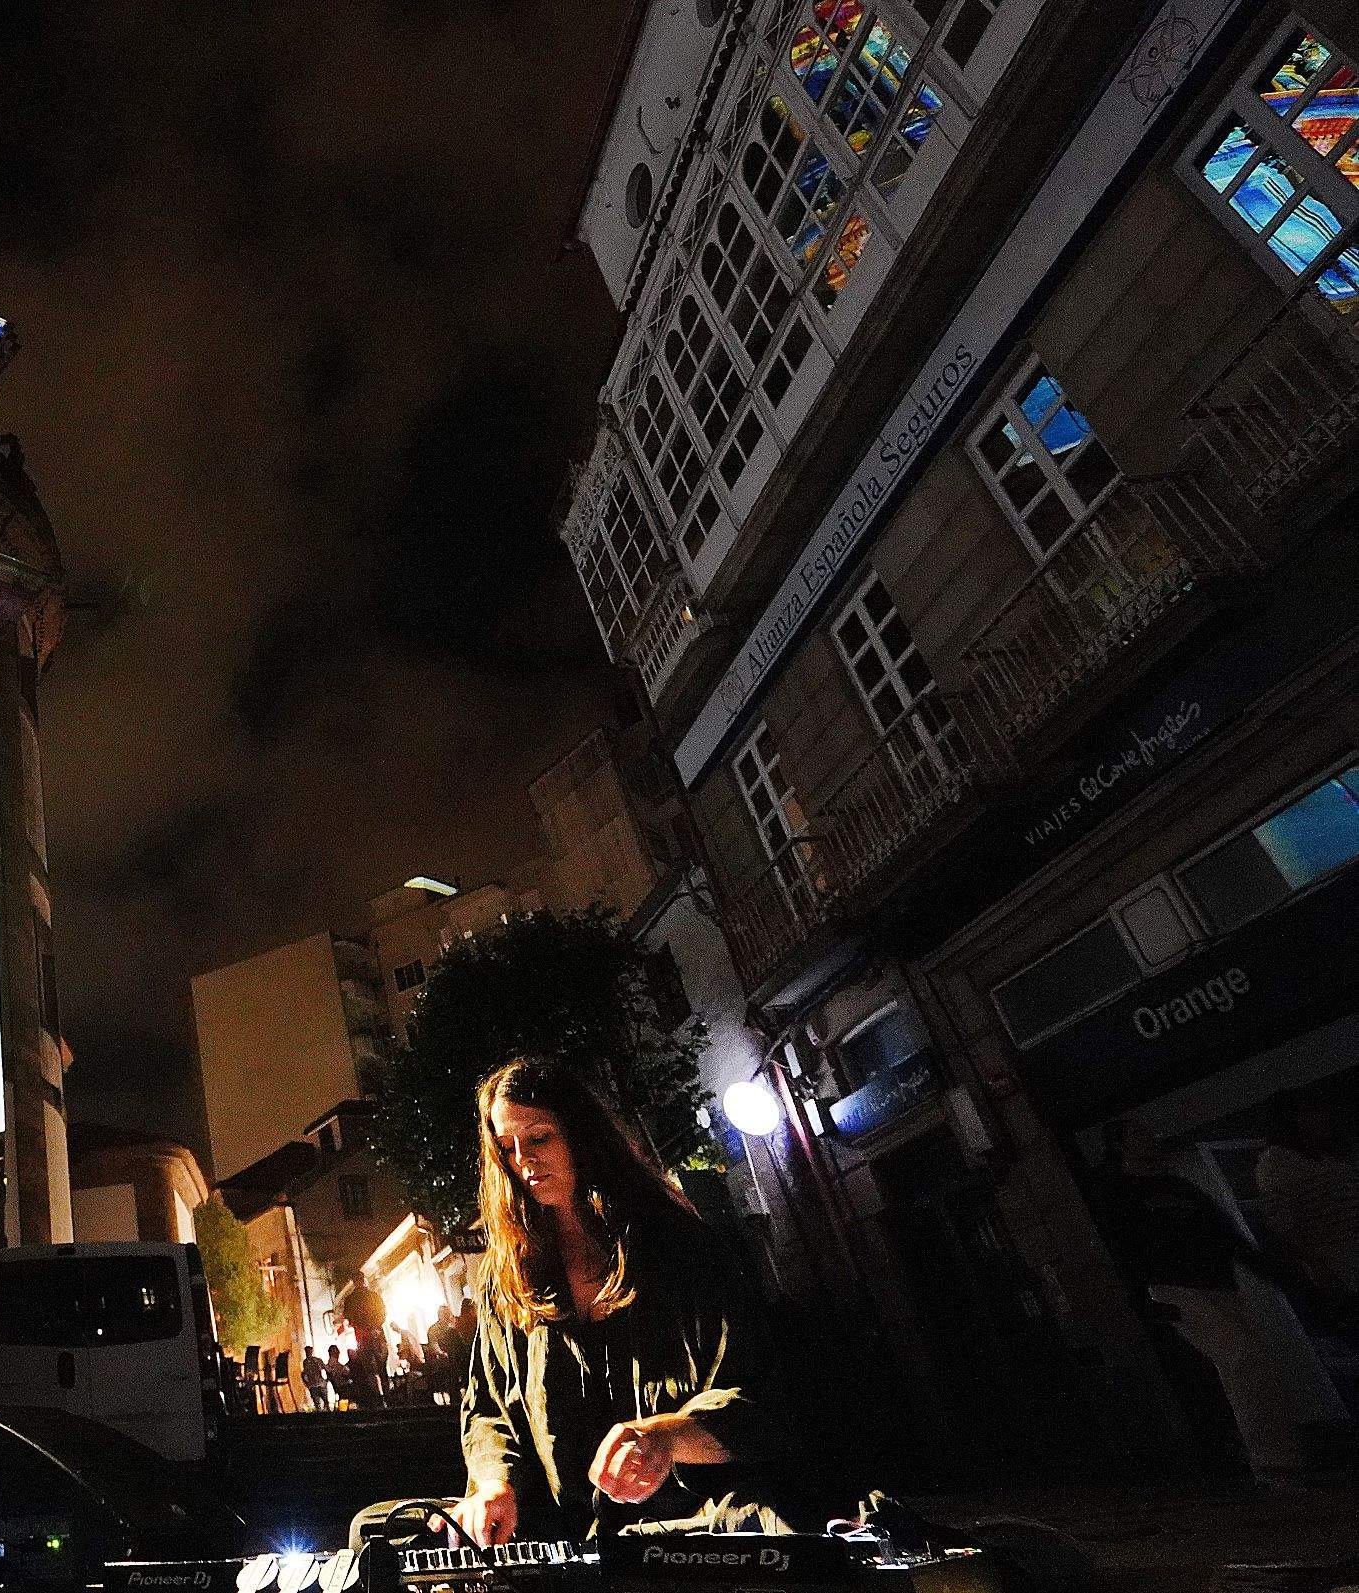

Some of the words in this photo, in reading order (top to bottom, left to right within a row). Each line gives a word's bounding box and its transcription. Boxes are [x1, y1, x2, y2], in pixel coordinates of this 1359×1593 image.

[748, 593, 804, 679] Alianza
[800, 477, 884, 593] Española
[880, 344, 973, 475] Seguros
[1024, 797, 1082, 845] VIAJES
[1132, 968, 1251, 1040] Orange
[128, 1571, 191, 1586] Pioneer
[643, 1546, 751, 1565] Pioneer
